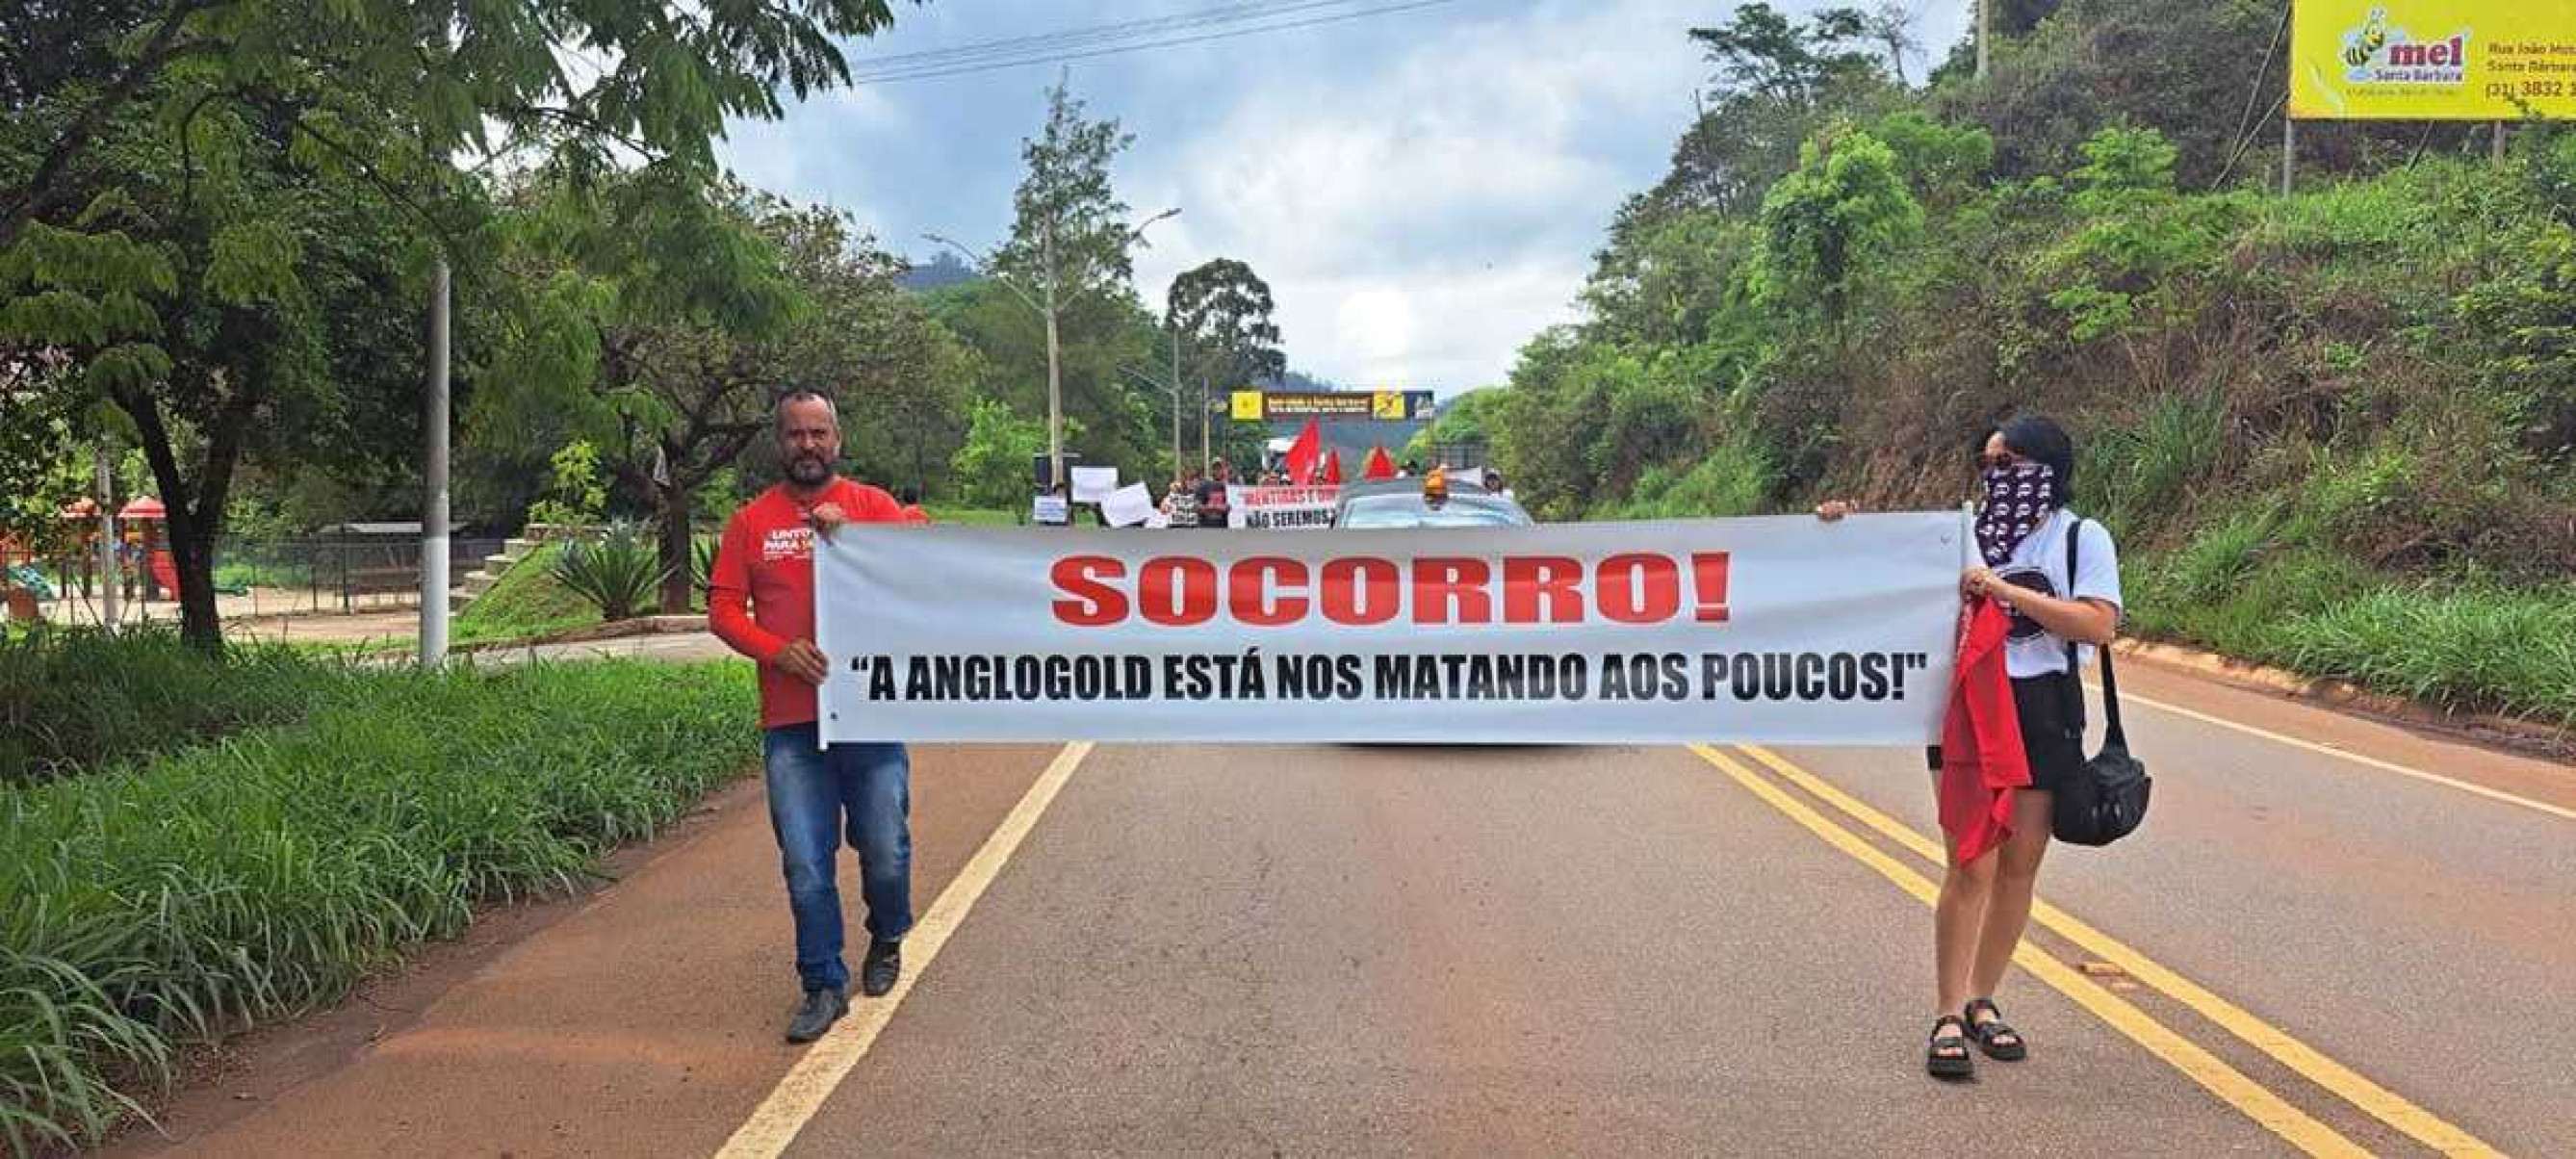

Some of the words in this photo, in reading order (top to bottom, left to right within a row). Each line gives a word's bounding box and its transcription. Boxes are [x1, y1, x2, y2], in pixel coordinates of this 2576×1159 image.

[2388, 37, 2464, 66] mel
[2486, 59, 2525, 71] Santa
[2374, 69, 2410, 82] Santa
[1051, 552, 1730, 627] SOCORRO!
[905, 654, 1150, 701] ANGLOGOLD
[1163, 647, 1264, 700] ESTÁ
[1276, 654, 1361, 700] NOS
[1375, 653, 1586, 700] MATANDO
[1601, 653, 1687, 701] AOS
[1702, 652, 1926, 701] POUCOS!"
